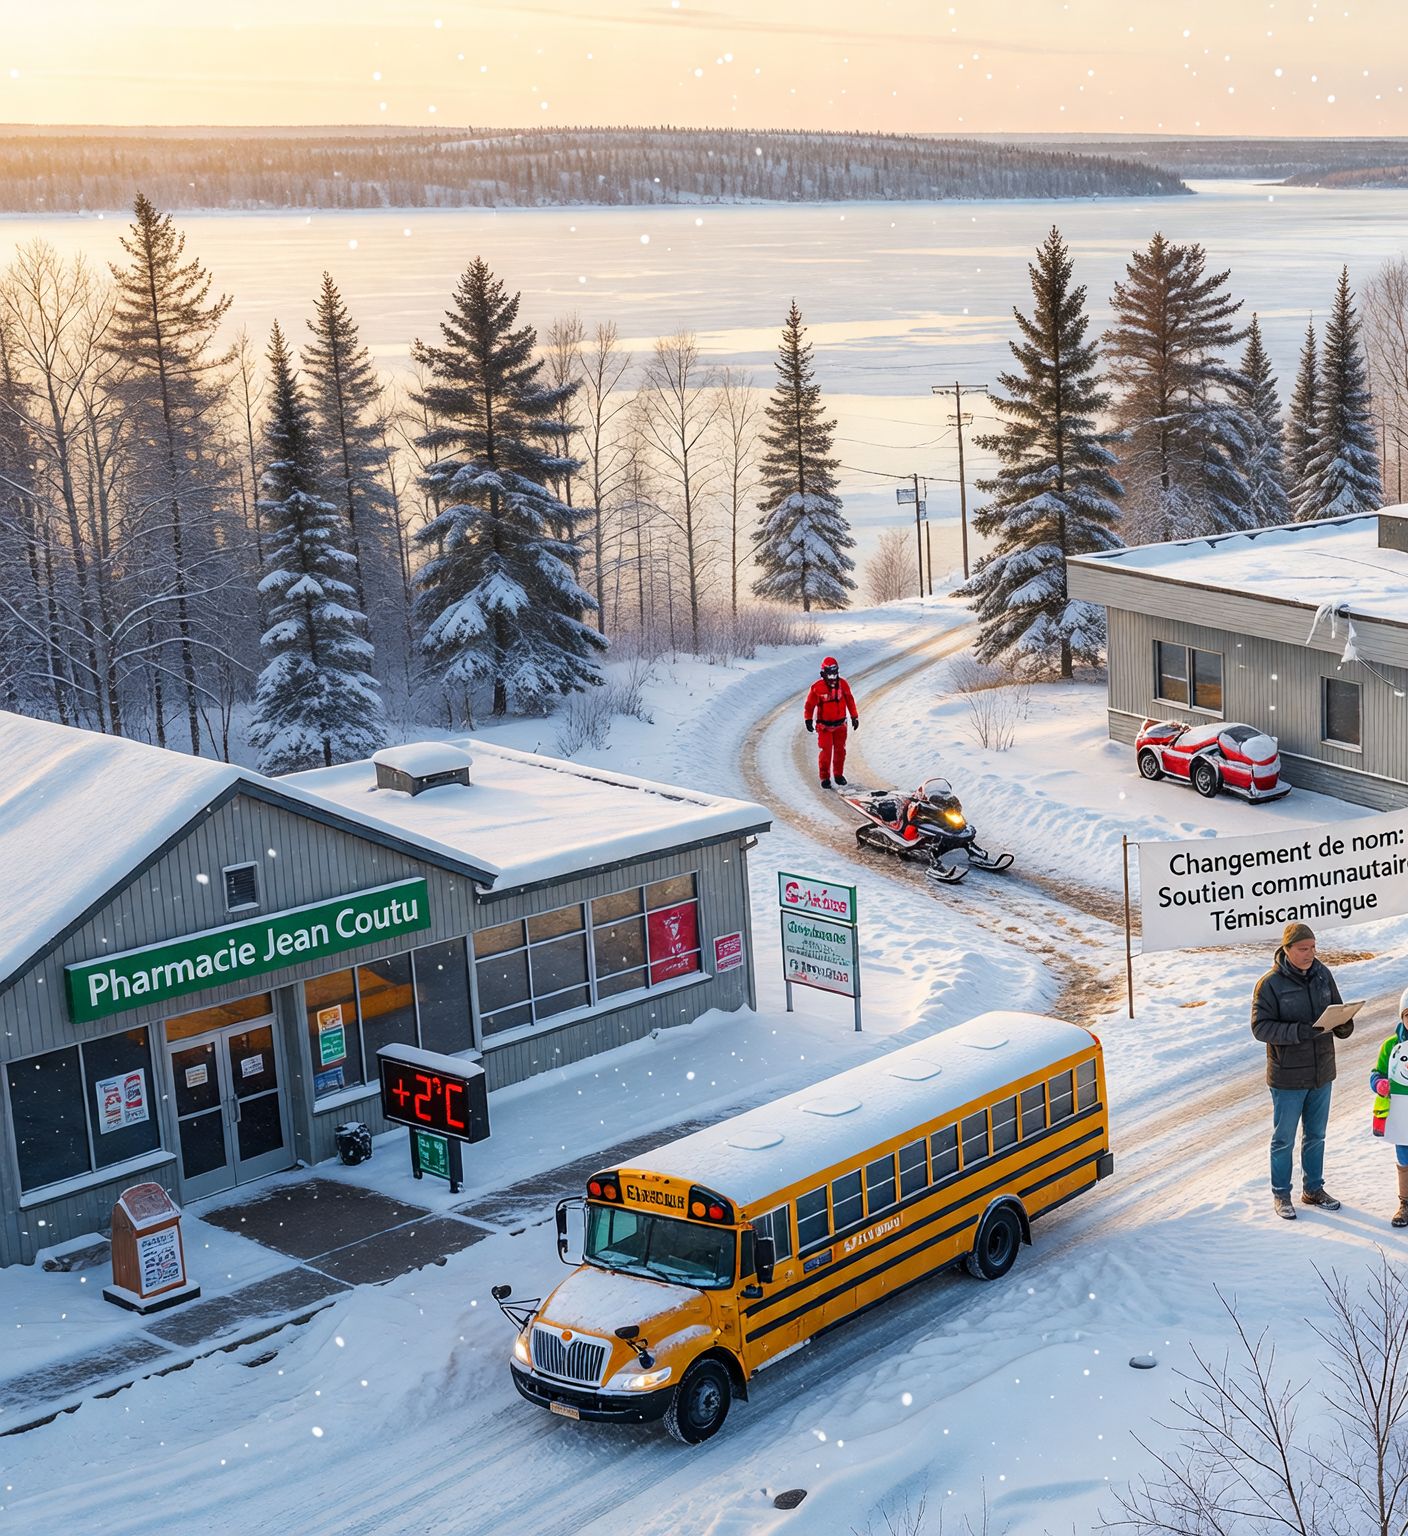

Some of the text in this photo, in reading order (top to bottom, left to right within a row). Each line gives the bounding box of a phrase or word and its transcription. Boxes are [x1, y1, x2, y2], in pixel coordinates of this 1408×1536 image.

[1169, 829, 1404, 876] Changement de nom:
[1158, 880, 1244, 908] Soutien
[1209, 893, 1378, 932] Témiscamingue
[88, 899, 418, 1007] Pharmacie Jean Coutu
